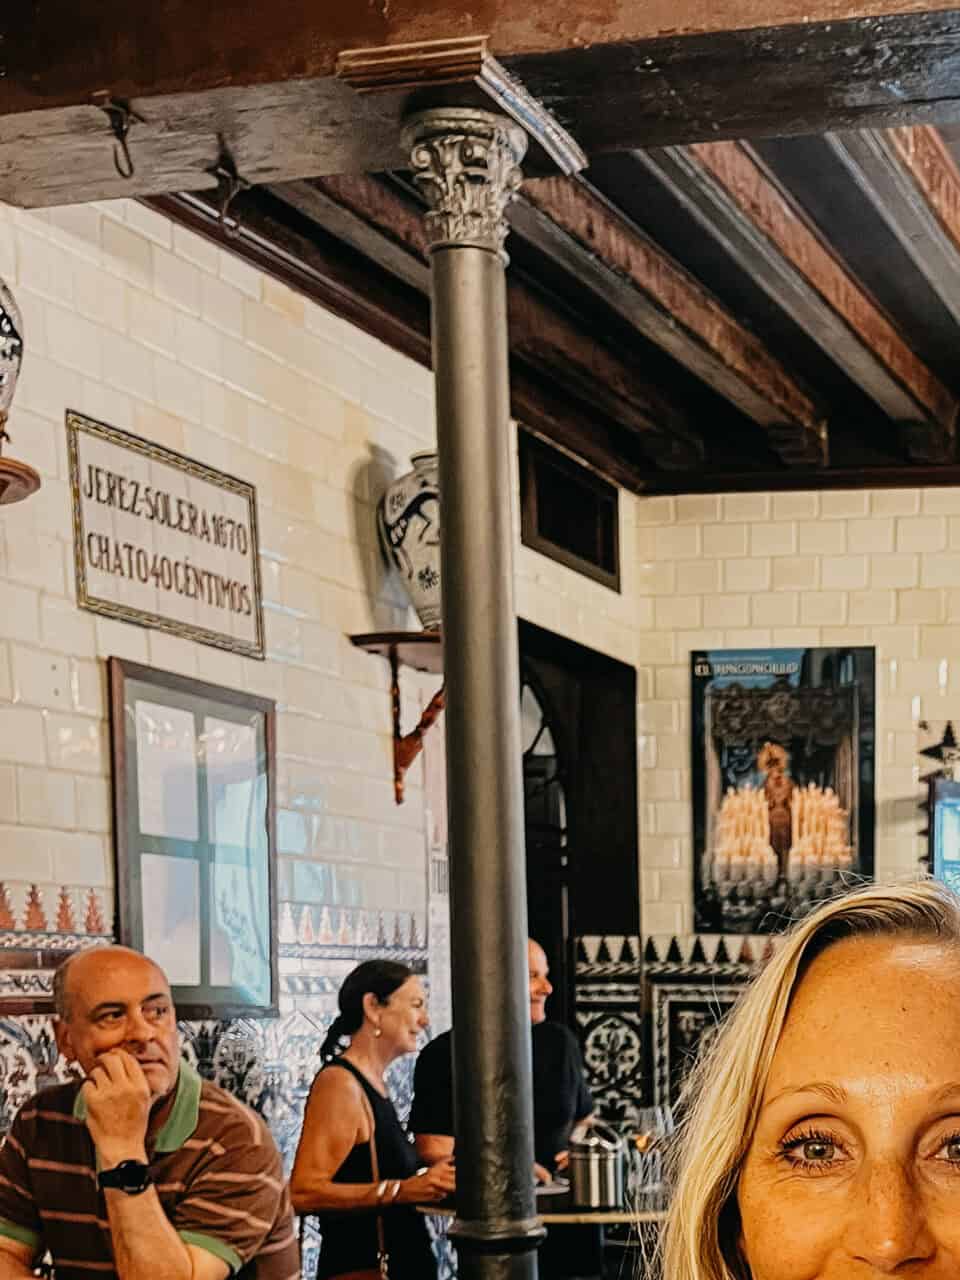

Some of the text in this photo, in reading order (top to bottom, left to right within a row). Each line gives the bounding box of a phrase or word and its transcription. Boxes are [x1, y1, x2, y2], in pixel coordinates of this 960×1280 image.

[212, 514, 248, 555] 1670
[87, 532, 148, 583] CHATO
[150, 553, 172, 591] 40
